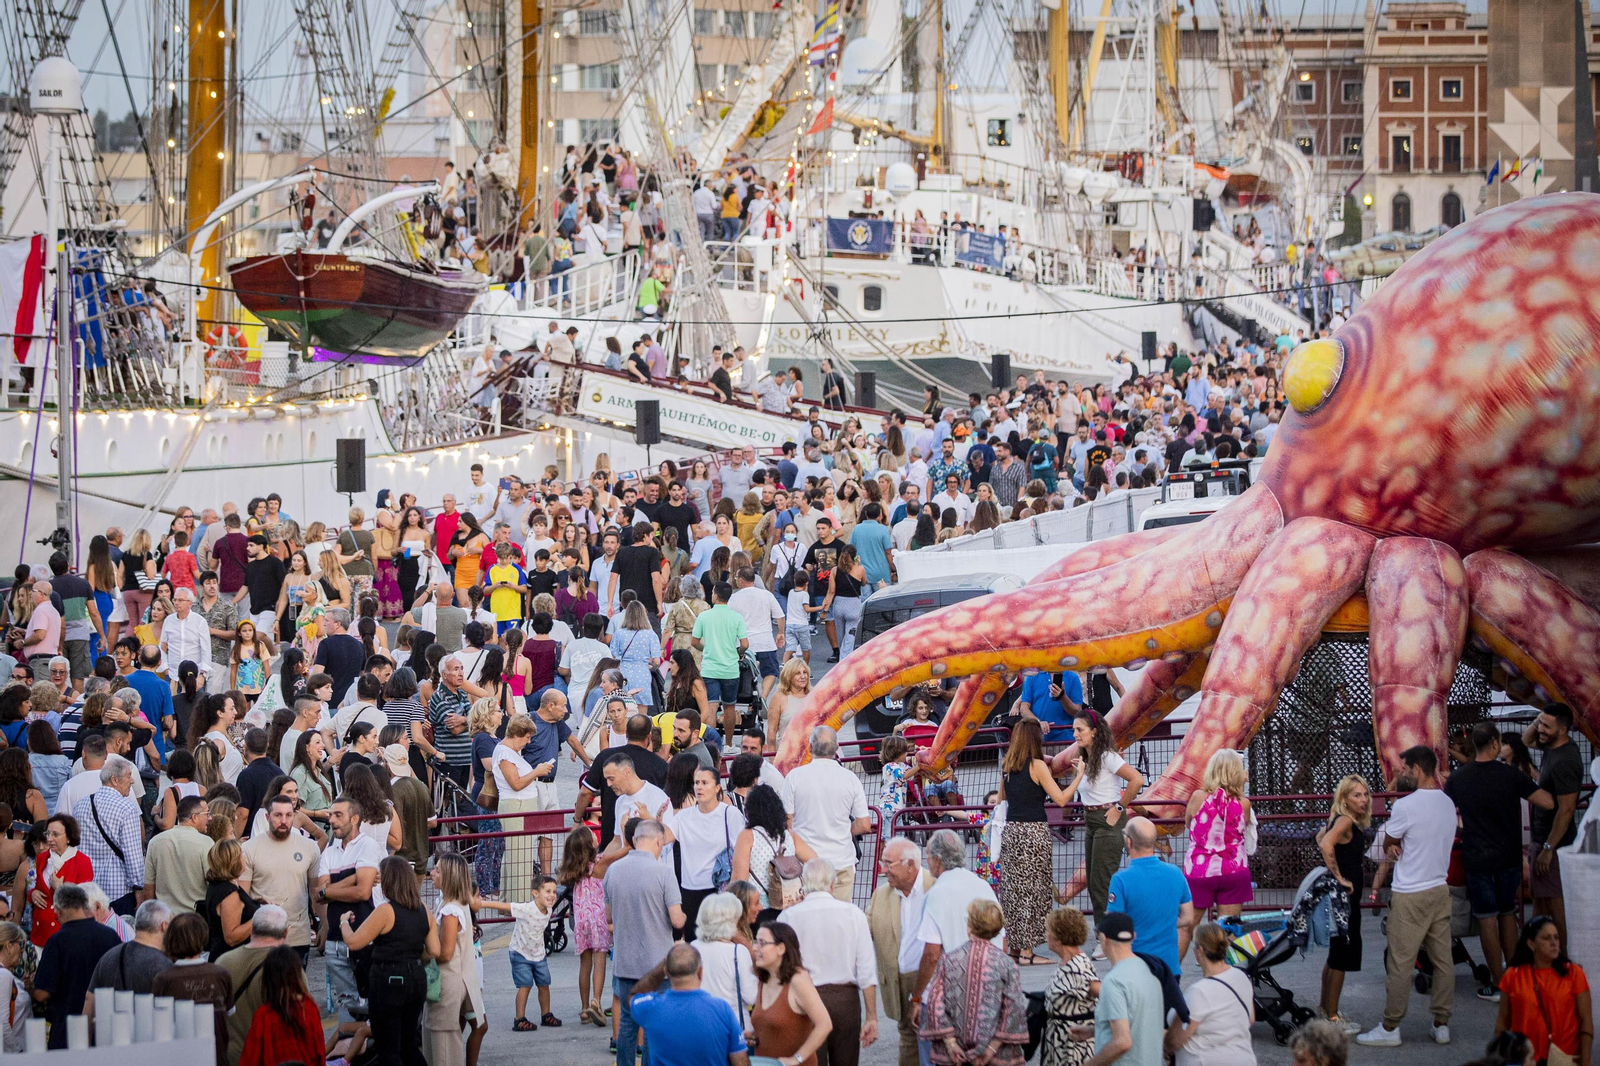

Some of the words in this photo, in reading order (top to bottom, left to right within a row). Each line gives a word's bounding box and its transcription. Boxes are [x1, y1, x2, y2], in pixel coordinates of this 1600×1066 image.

[39, 89, 63, 97] SAILOR
[607, 394, 637, 411] ARM
[658, 406, 736, 434] AUHTÉMOC
[740, 426, 776, 443] BE-01
[510, 620, 518, 629] 7
